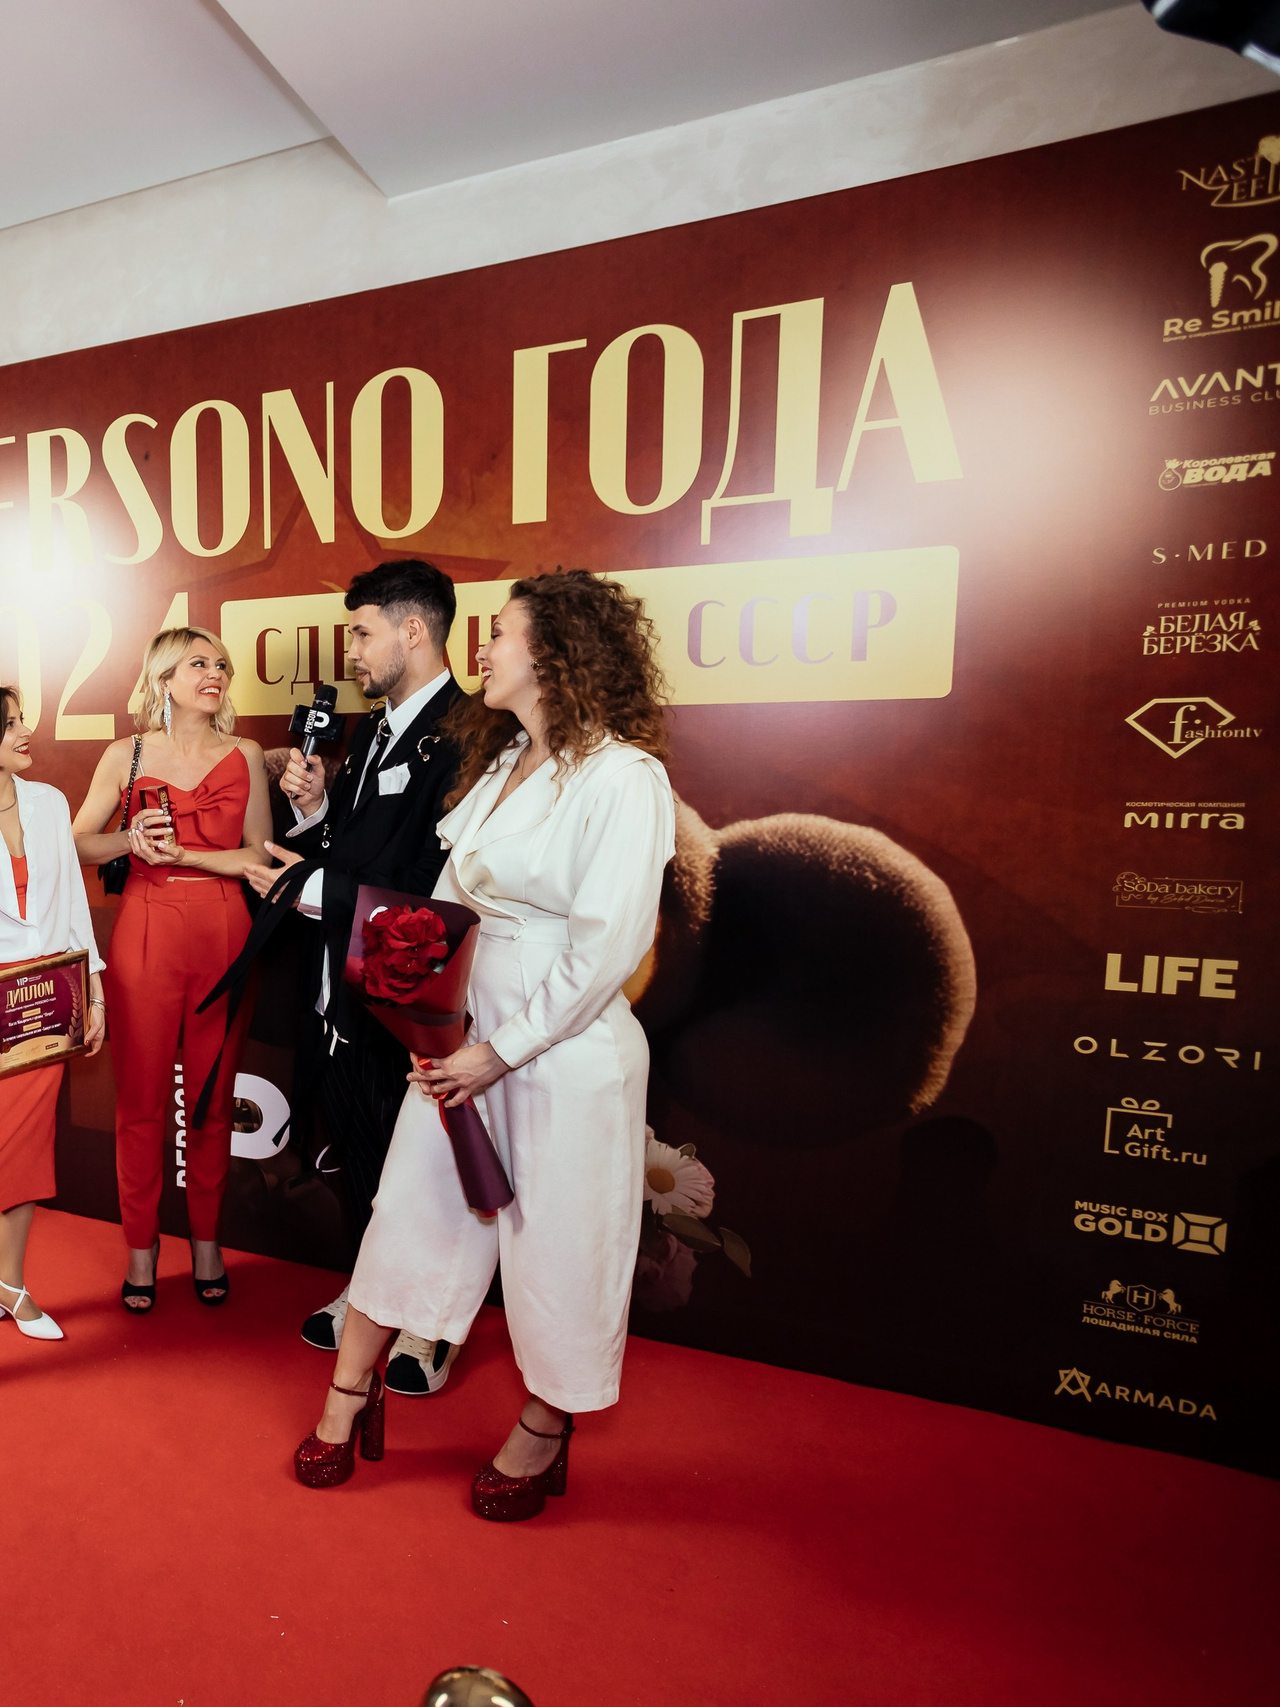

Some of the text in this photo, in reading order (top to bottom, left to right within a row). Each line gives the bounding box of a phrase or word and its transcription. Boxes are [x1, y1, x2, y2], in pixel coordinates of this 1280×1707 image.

[1163, 318, 1202, 336] Re
[1211, 300, 1280, 328] Smil
[1150, 363, 1280, 402] AVANT
[511, 281, 964, 545] ГОДА
[1149, 389, 1280, 415] BUSINESS CL
[1182, 451, 1276, 469] Королевская
[1182, 461, 1272, 484] ВОДА
[1157, 598, 1251, 608] PREMIUM VODKA
[687, 589, 898, 668] СССР
[1159, 611, 1247, 634] БЕЛАЯ
[1142, 632, 1260, 656] БЕРЁЗКА
[304, 709, 317, 733] PERSON
[1175, 883, 1239, 899] bakery
[1105, 953, 1239, 999] LIFE
[6, 980, 54, 1009] ДИПЛОМ
[1073, 1036, 1262, 1070] OLZORI
[1127, 1124, 1166, 1142] Art
[1125, 1142, 1207, 1166] Gift.ru
[1074, 1200, 1168, 1223] MUSIC BOX
[1074, 1213, 1168, 1243] GOLD
[1081, 1316, 1198, 1344] ЛОШАДИНАЯ СИЛА
[1082, 1303, 1200, 1334] HORSE FORCE
[1094, 1382, 1217, 1421] ARMADA
